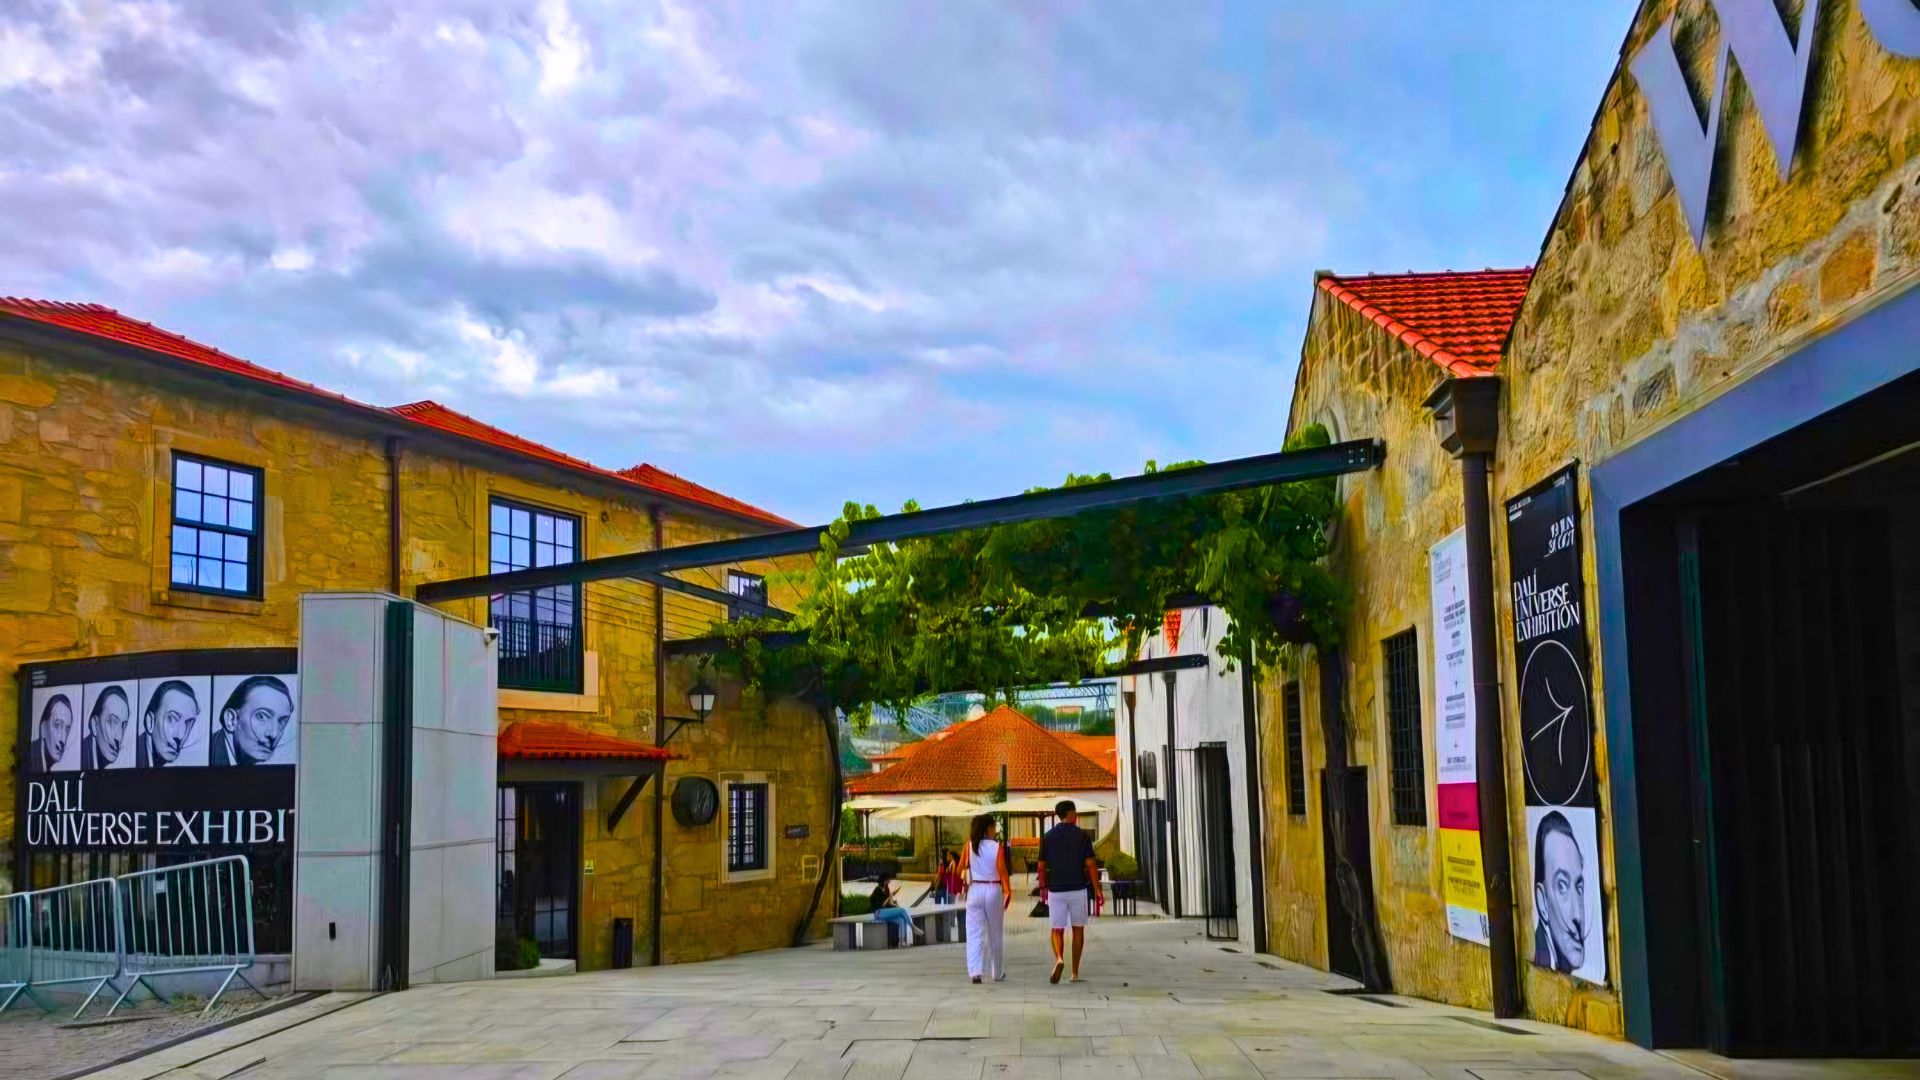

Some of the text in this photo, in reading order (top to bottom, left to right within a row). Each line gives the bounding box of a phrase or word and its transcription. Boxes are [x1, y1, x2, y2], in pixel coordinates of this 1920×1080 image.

[1628, 0, 1920, 254] W
[1513, 567, 1537, 602] DALÍ
[1514, 582, 1570, 621] UNIVERSE
[1516, 601, 1580, 642] EXHIBITION
[27, 772, 85, 813] DALÍ
[26, 808, 296, 846] UNIVERSE EXHIBI
